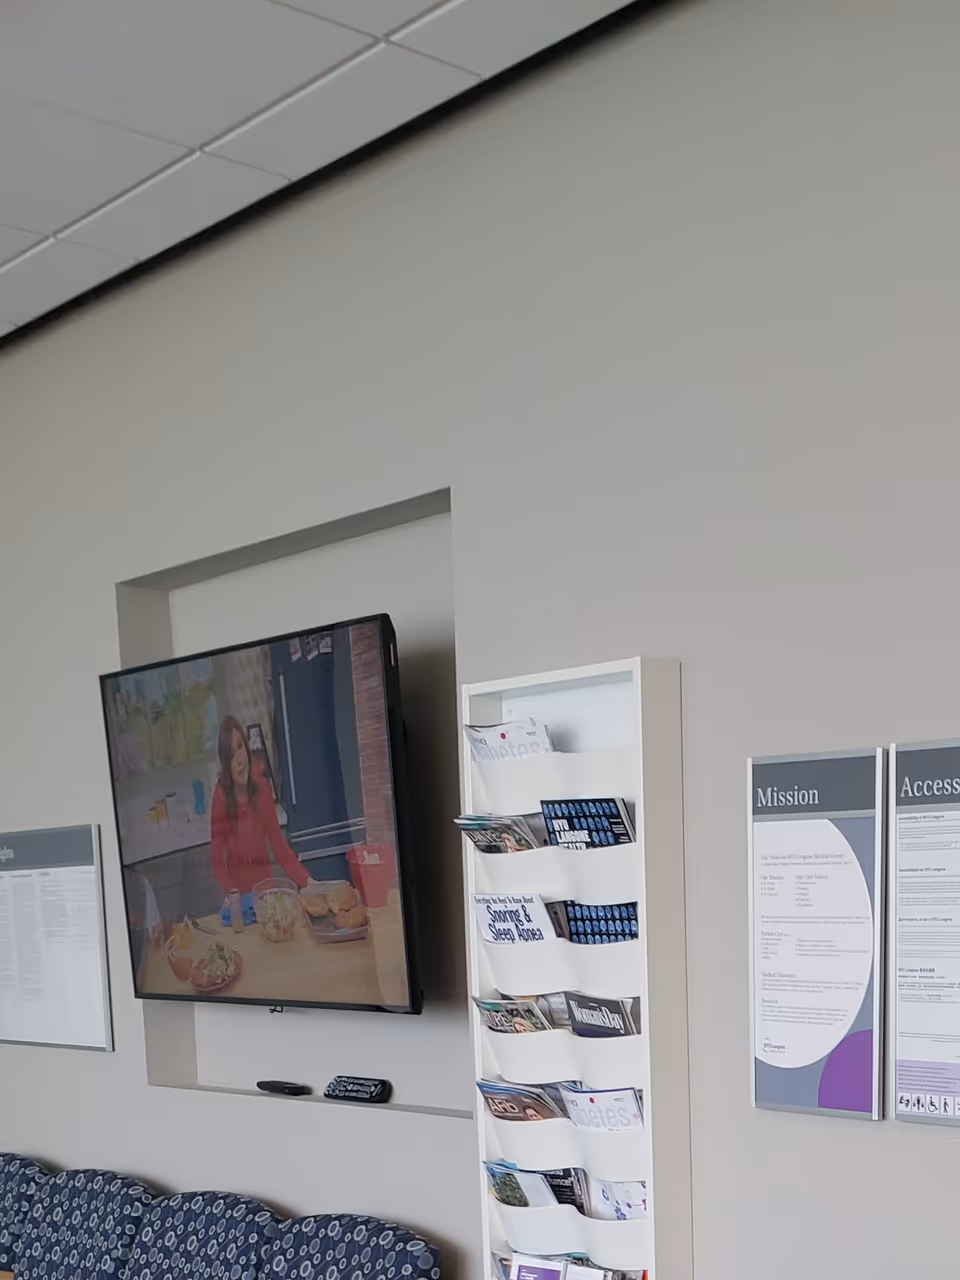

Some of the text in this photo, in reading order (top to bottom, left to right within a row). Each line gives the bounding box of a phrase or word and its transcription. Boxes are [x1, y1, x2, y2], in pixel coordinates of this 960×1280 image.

[757, 785, 819, 807] Mission
[552, 819, 569, 831] NYU
[555, 830, 591, 843] LANGONE
[486, 904, 533, 926] Snoring &
[488, 922, 544, 944] Sleep Apnea
[488, 1098, 519, 1112] AFib
